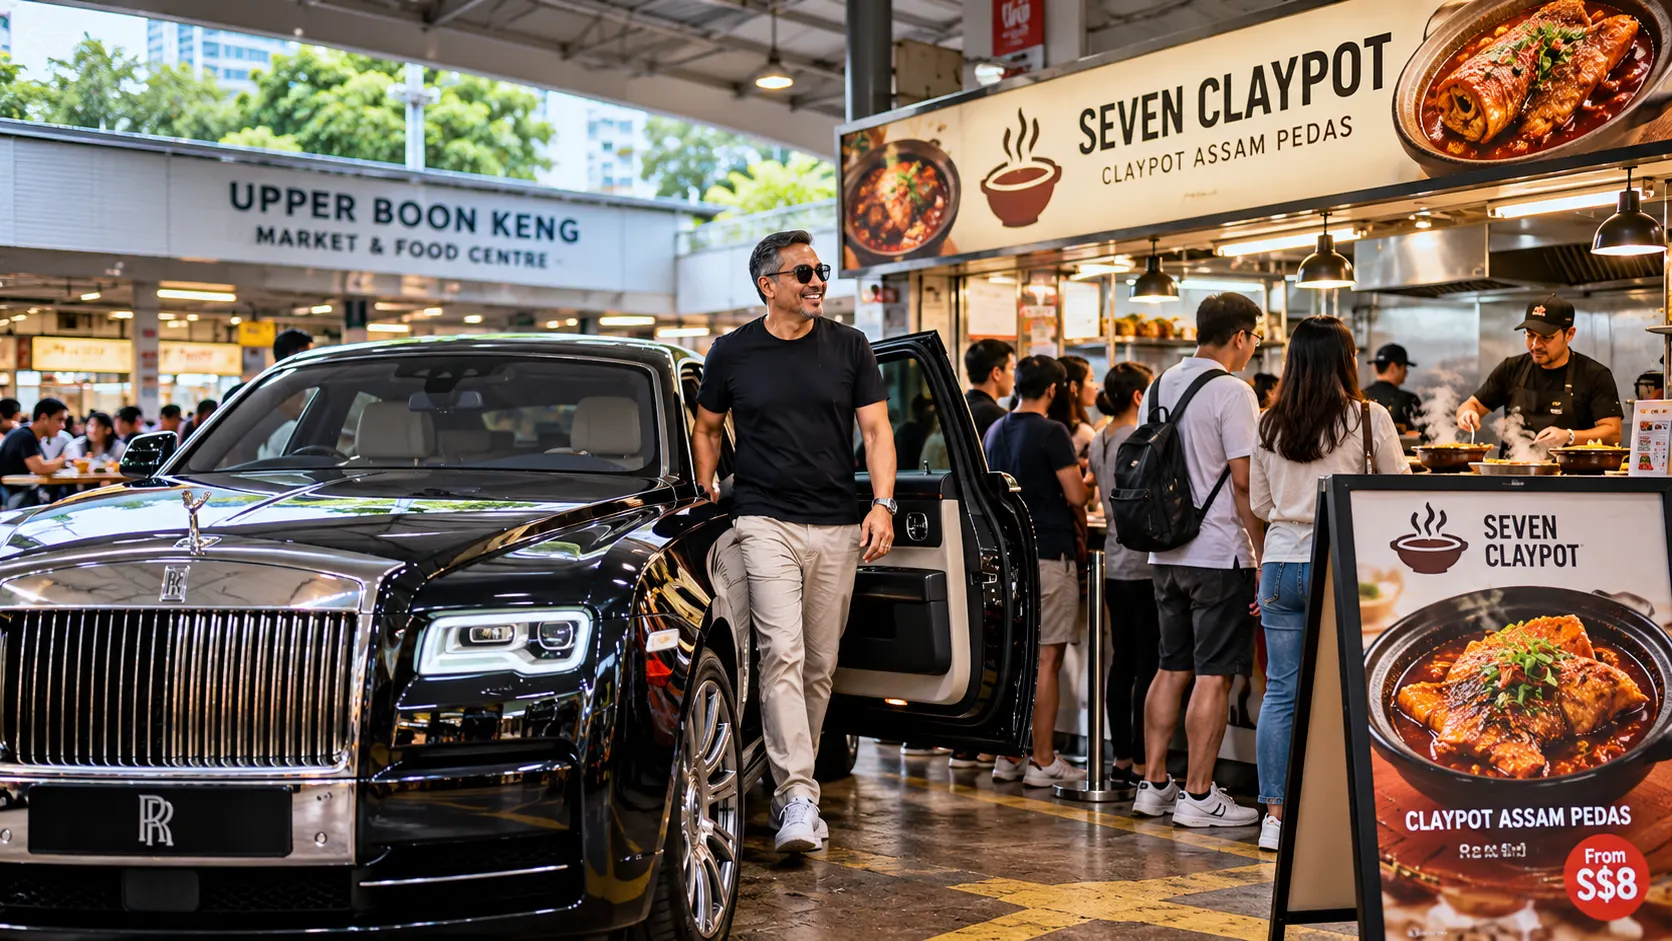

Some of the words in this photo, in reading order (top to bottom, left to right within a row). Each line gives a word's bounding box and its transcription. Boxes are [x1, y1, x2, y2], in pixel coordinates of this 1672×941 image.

[1078, 85, 1183, 155] SEVEN
[1198, 31, 1392, 128] CLAYPOT
[1101, 151, 1185, 185] CLAYPOT
[1193, 134, 1265, 167] ASSAM
[1277, 115, 1353, 151] PEDAS
[229, 181, 356, 222] UPPER
[373, 198, 477, 233] BOON
[492, 211, 580, 243] KENG
[255, 225, 359, 252] MARKET
[369, 237, 384, 255] &
[395, 238, 459, 261] FOOD
[468, 246, 549, 269] CENTRE
[1483, 514, 1557, 540] SEVEN
[1485, 543, 1580, 567] CLAYPOT
[138, 794, 175, 847] RR
[1404, 809, 1493, 831] CLAYPOT
[1498, 807, 1565, 829] ASSAM
[1570, 805, 1632, 826] PEDAS
[1584, 847, 1627, 864] From
[1576, 865, 1638, 903] S$8
